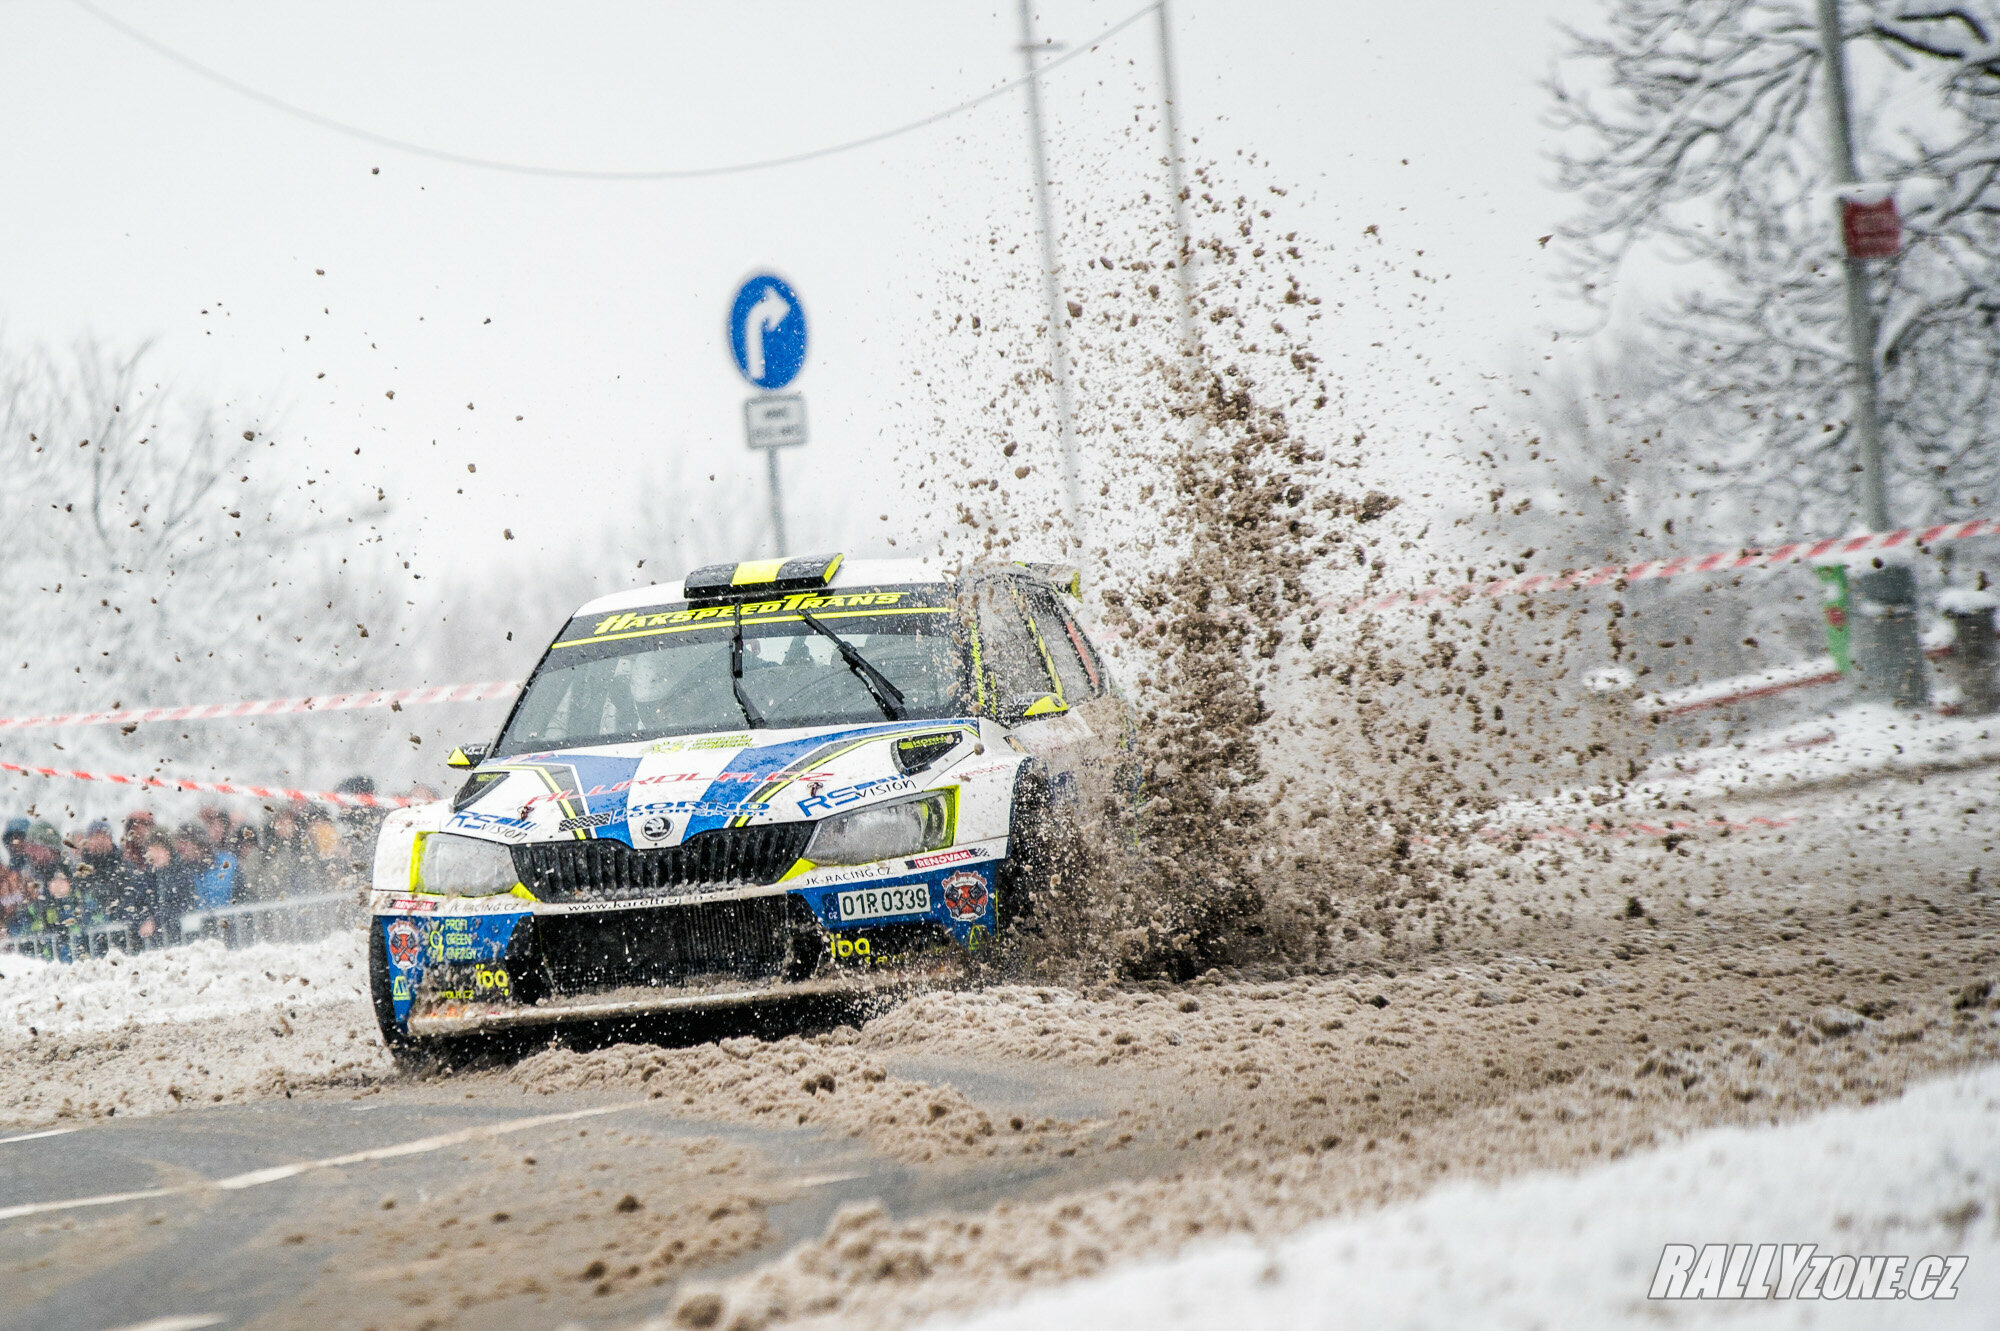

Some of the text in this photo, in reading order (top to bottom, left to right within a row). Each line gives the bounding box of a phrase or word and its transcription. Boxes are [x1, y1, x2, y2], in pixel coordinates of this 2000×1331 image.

[917, 850, 970, 868] RENOVAK
[843, 888, 928, 916] 01R 0339
[446, 933, 473, 946] GREEN
